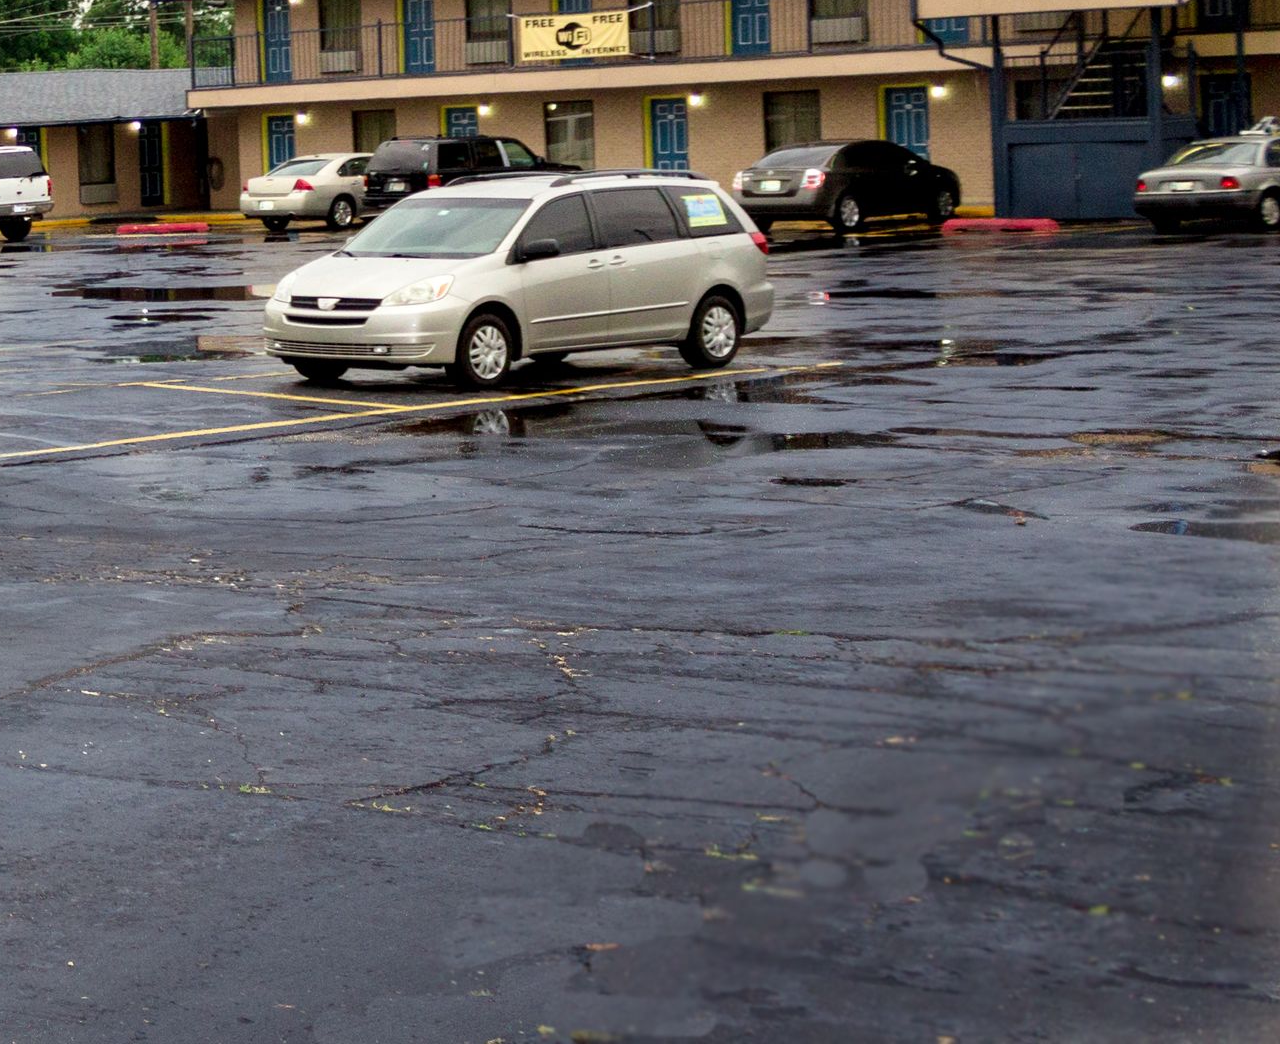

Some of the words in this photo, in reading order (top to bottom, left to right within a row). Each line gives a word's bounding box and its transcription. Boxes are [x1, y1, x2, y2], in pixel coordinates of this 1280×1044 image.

[525, 19, 555, 28] FREE
[592, 14, 623, 24] FREE
[524, 50, 567, 58] WIRELESS
[581, 46, 626, 55] INTERNET
